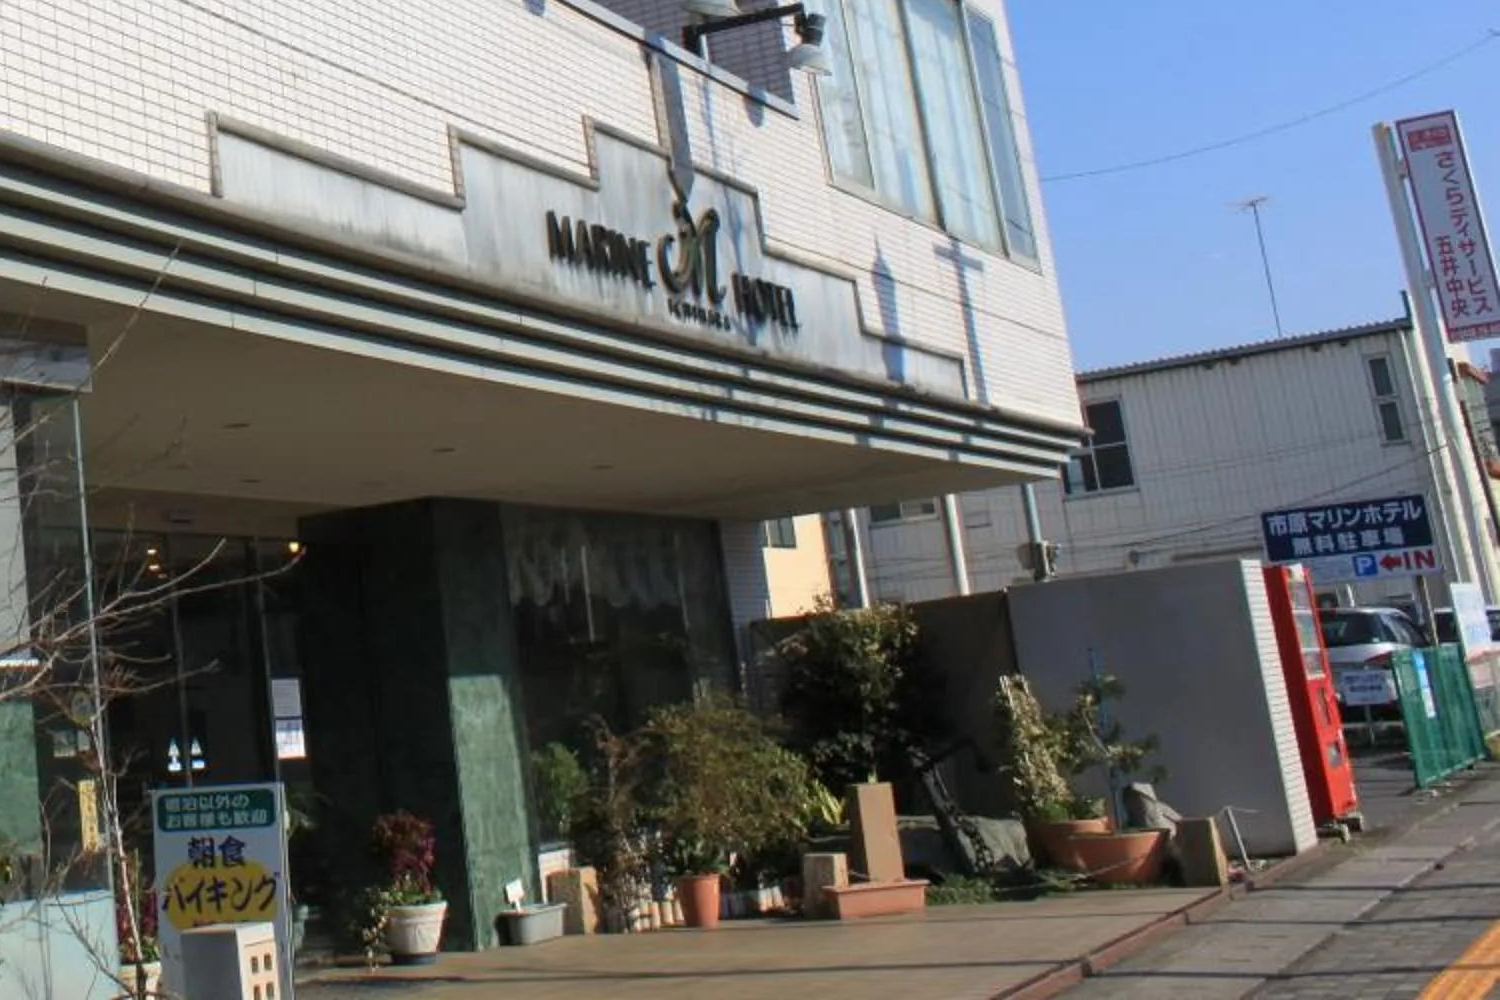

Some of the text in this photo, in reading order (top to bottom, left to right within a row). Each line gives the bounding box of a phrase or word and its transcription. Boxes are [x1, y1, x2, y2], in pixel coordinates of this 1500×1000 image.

[1436, 234, 1471, 318] 五井中央
[1267, 499, 1422, 537] 市原マリンホテル
[1291, 527, 1405, 557] 無料駐車場
[1403, 550, 1436, 569] IN
[187, 834, 246, 869] 朝食
[161, 871, 281, 913] バイキング
